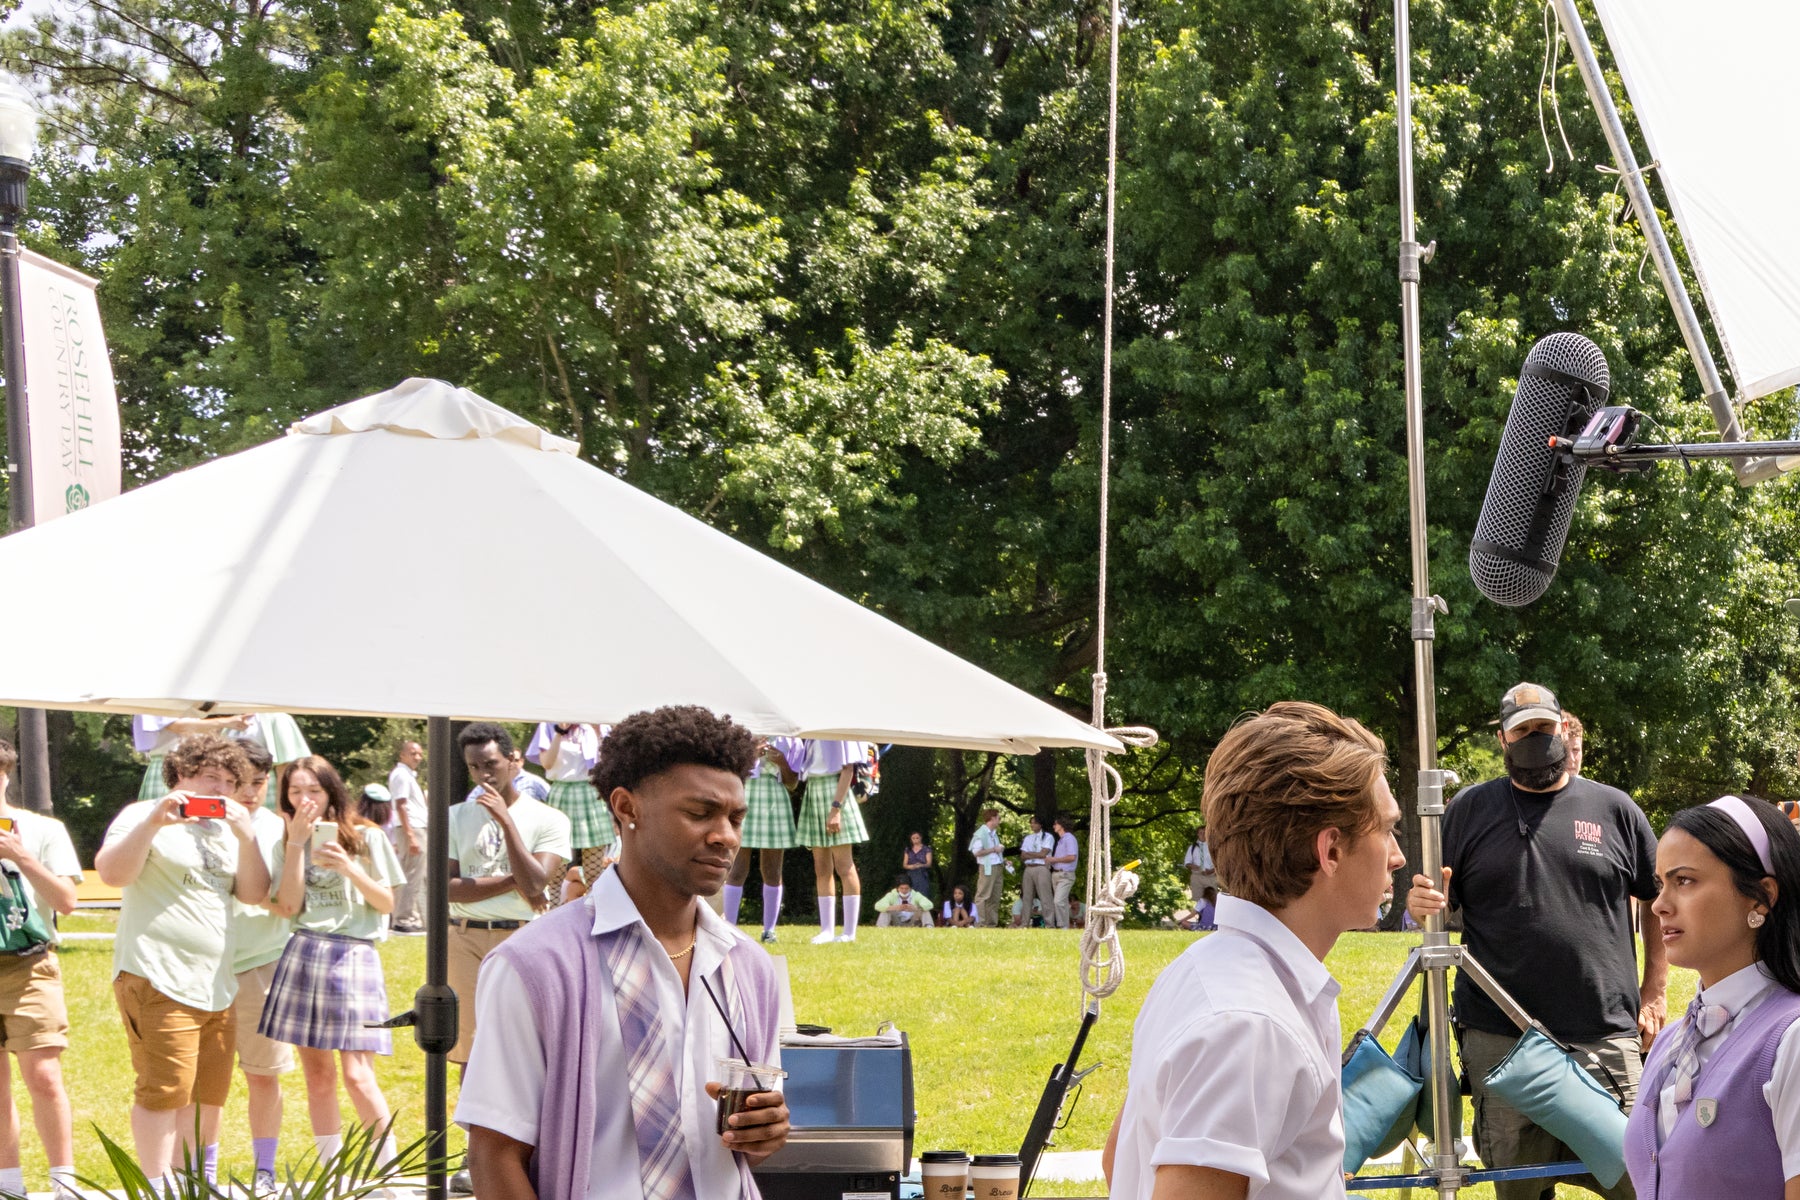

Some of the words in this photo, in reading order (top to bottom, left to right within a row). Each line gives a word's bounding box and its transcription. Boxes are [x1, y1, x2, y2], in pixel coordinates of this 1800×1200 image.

[48, 286, 71, 417] COUNTRY
[61, 426, 74, 476] DAY
[63, 293, 93, 476] ROSEHILL
[1574, 820, 1601, 837] DOOM
[1576, 833, 1602, 844] PATROL
[939, 1184, 964, 1193] Brew
[989, 1187, 1013, 1196] Brew
